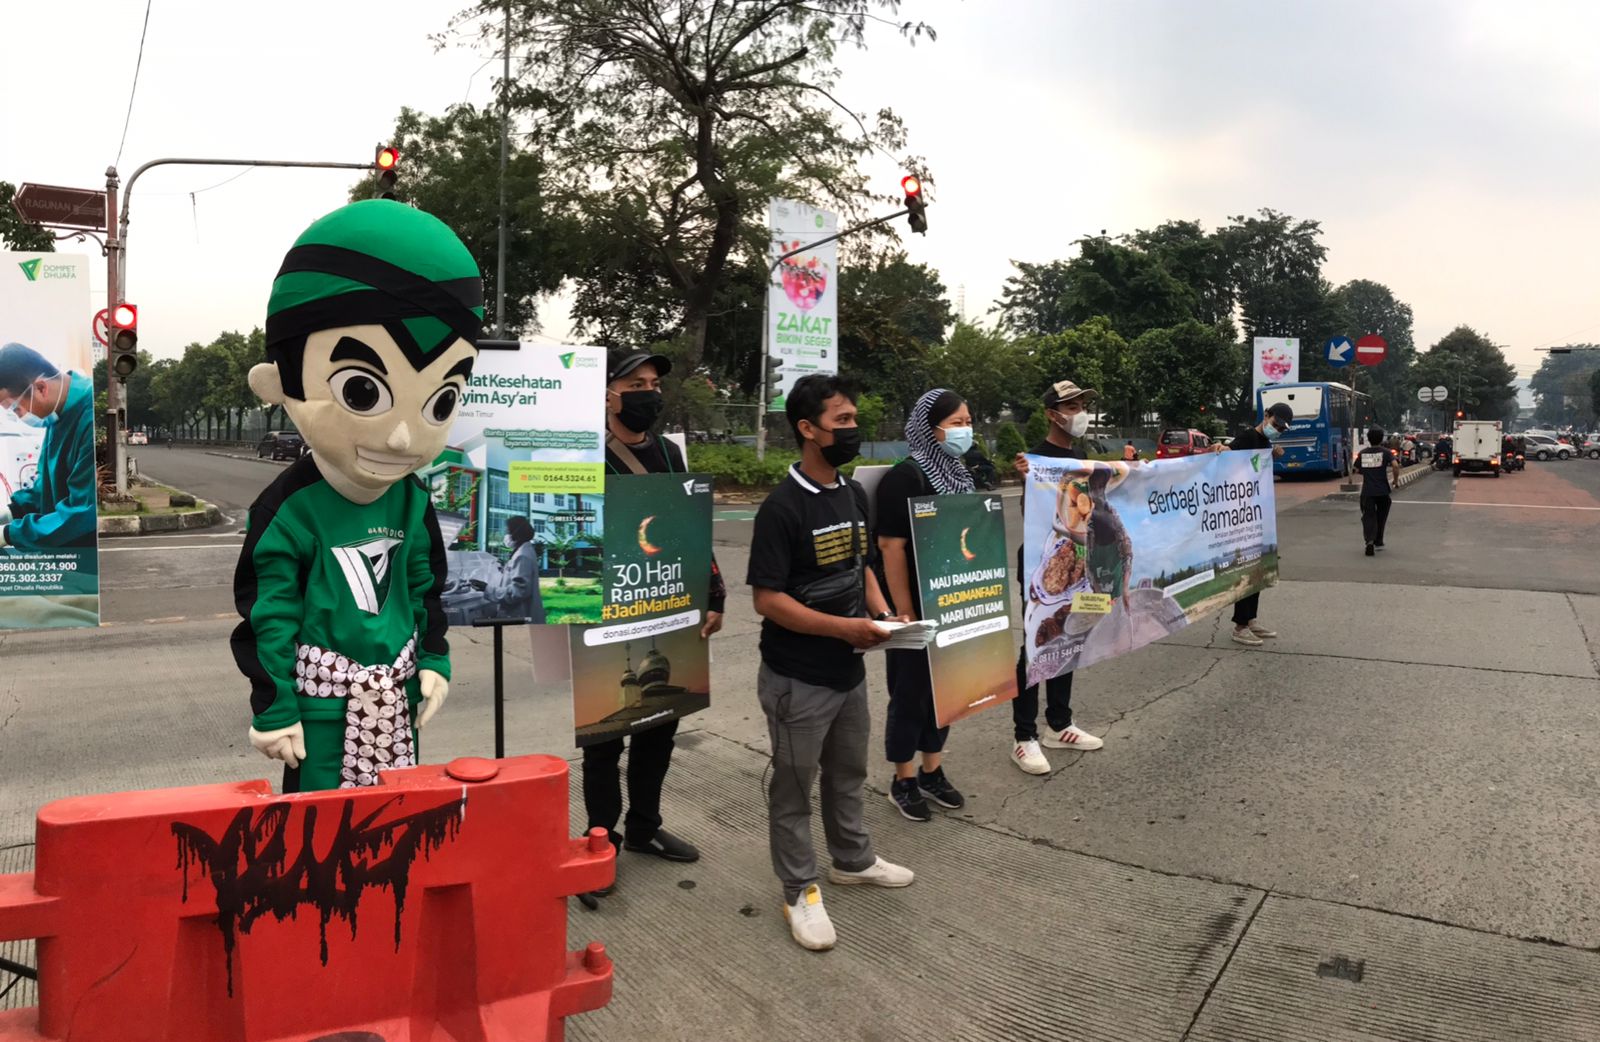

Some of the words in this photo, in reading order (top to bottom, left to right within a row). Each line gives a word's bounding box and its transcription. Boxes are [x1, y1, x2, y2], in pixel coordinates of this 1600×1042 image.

[25, 198, 71, 211] RAGUNAN
[777, 312, 832, 335] ZAKAT
[777, 333, 802, 344] BIKIN
[804, 335, 832, 347] SEGER
[489, 374, 562, 389] Kesehatan
[459, 390, 488, 406] yim
[491, 391, 537, 408] Asy'ari
[1148, 482, 1199, 516] Berbagi
[1202, 480, 1260, 506] Santapan
[1201, 501, 1262, 532] Ramadan
[612, 563, 641, 587] 30
[646, 557, 682, 584] Hari
[930, 575, 951, 590] MAU
[952, 569, 993, 586] RAMADAN
[993, 567, 1006, 578] MU
[611, 581, 684, 603] Ramadan
[938, 584, 1003, 607] #JADIMANFAAT?
[602, 593, 691, 620] #JadiManfaat
[941, 608, 964, 625] MARI
[965, 604, 985, 619] IKUTI
[985, 600, 1004, 614] KAMI
[602, 617, 690, 639] donasi.dompetdhuafa.org
